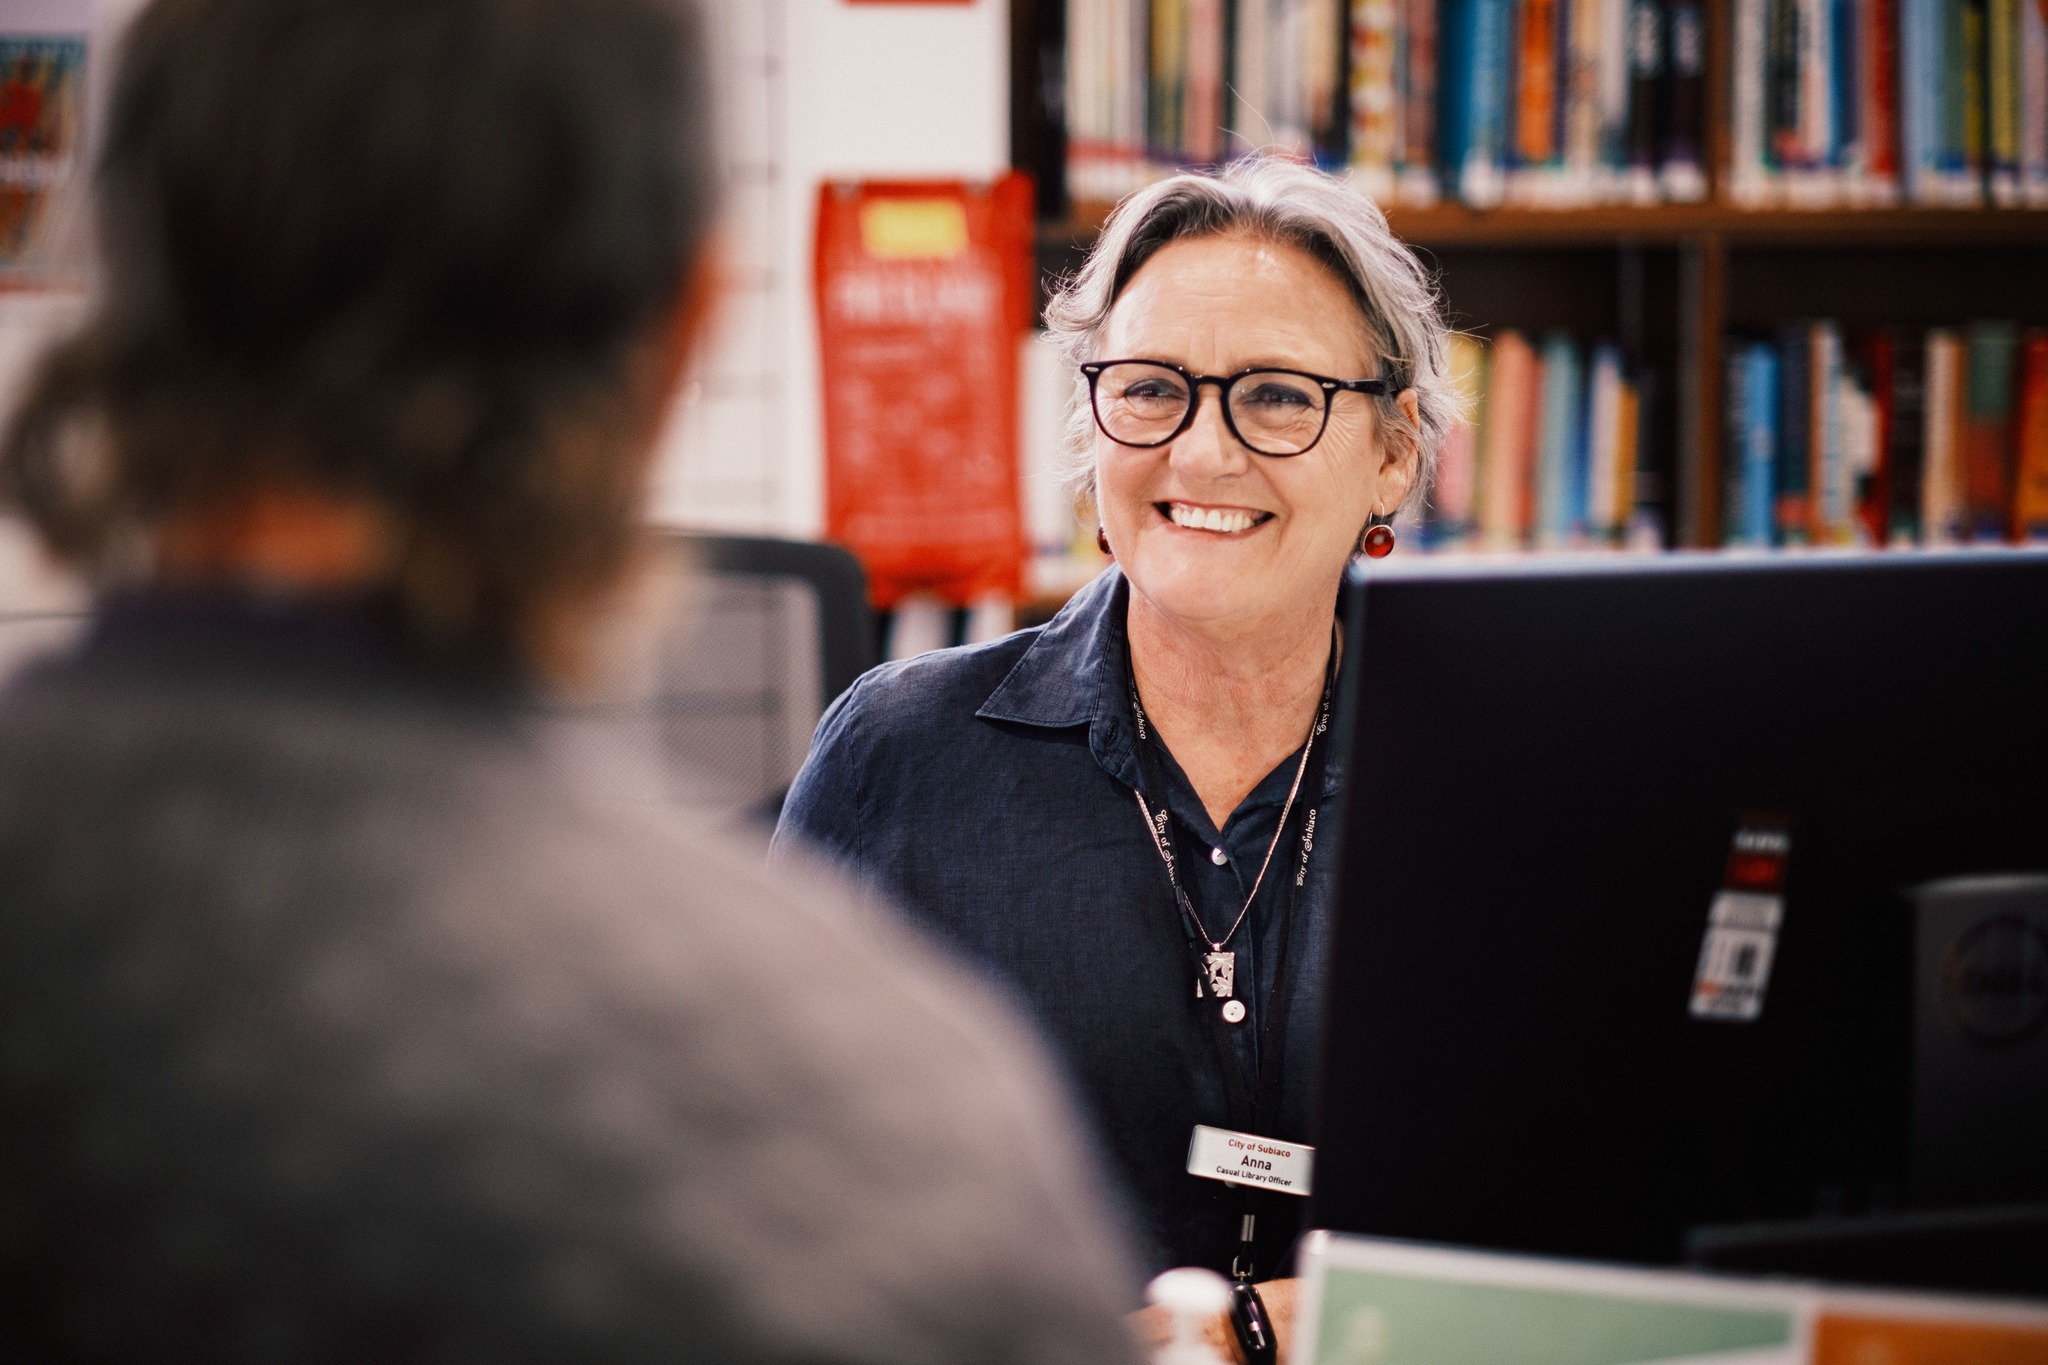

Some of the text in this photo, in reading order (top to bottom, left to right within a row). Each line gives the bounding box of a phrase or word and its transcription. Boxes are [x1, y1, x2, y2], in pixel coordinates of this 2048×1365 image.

[1316, 713, 1330, 735] City
[1155, 809, 1168, 834] City
[1160, 837, 1171, 847] of
[1296, 808, 1316, 886] City of Subiaco
[1228, 1138, 1291, 1158] City of Subiaco
[1241, 1154, 1272, 1171] Anna
[1216, 1165, 1292, 1187] Casual Library Officer
